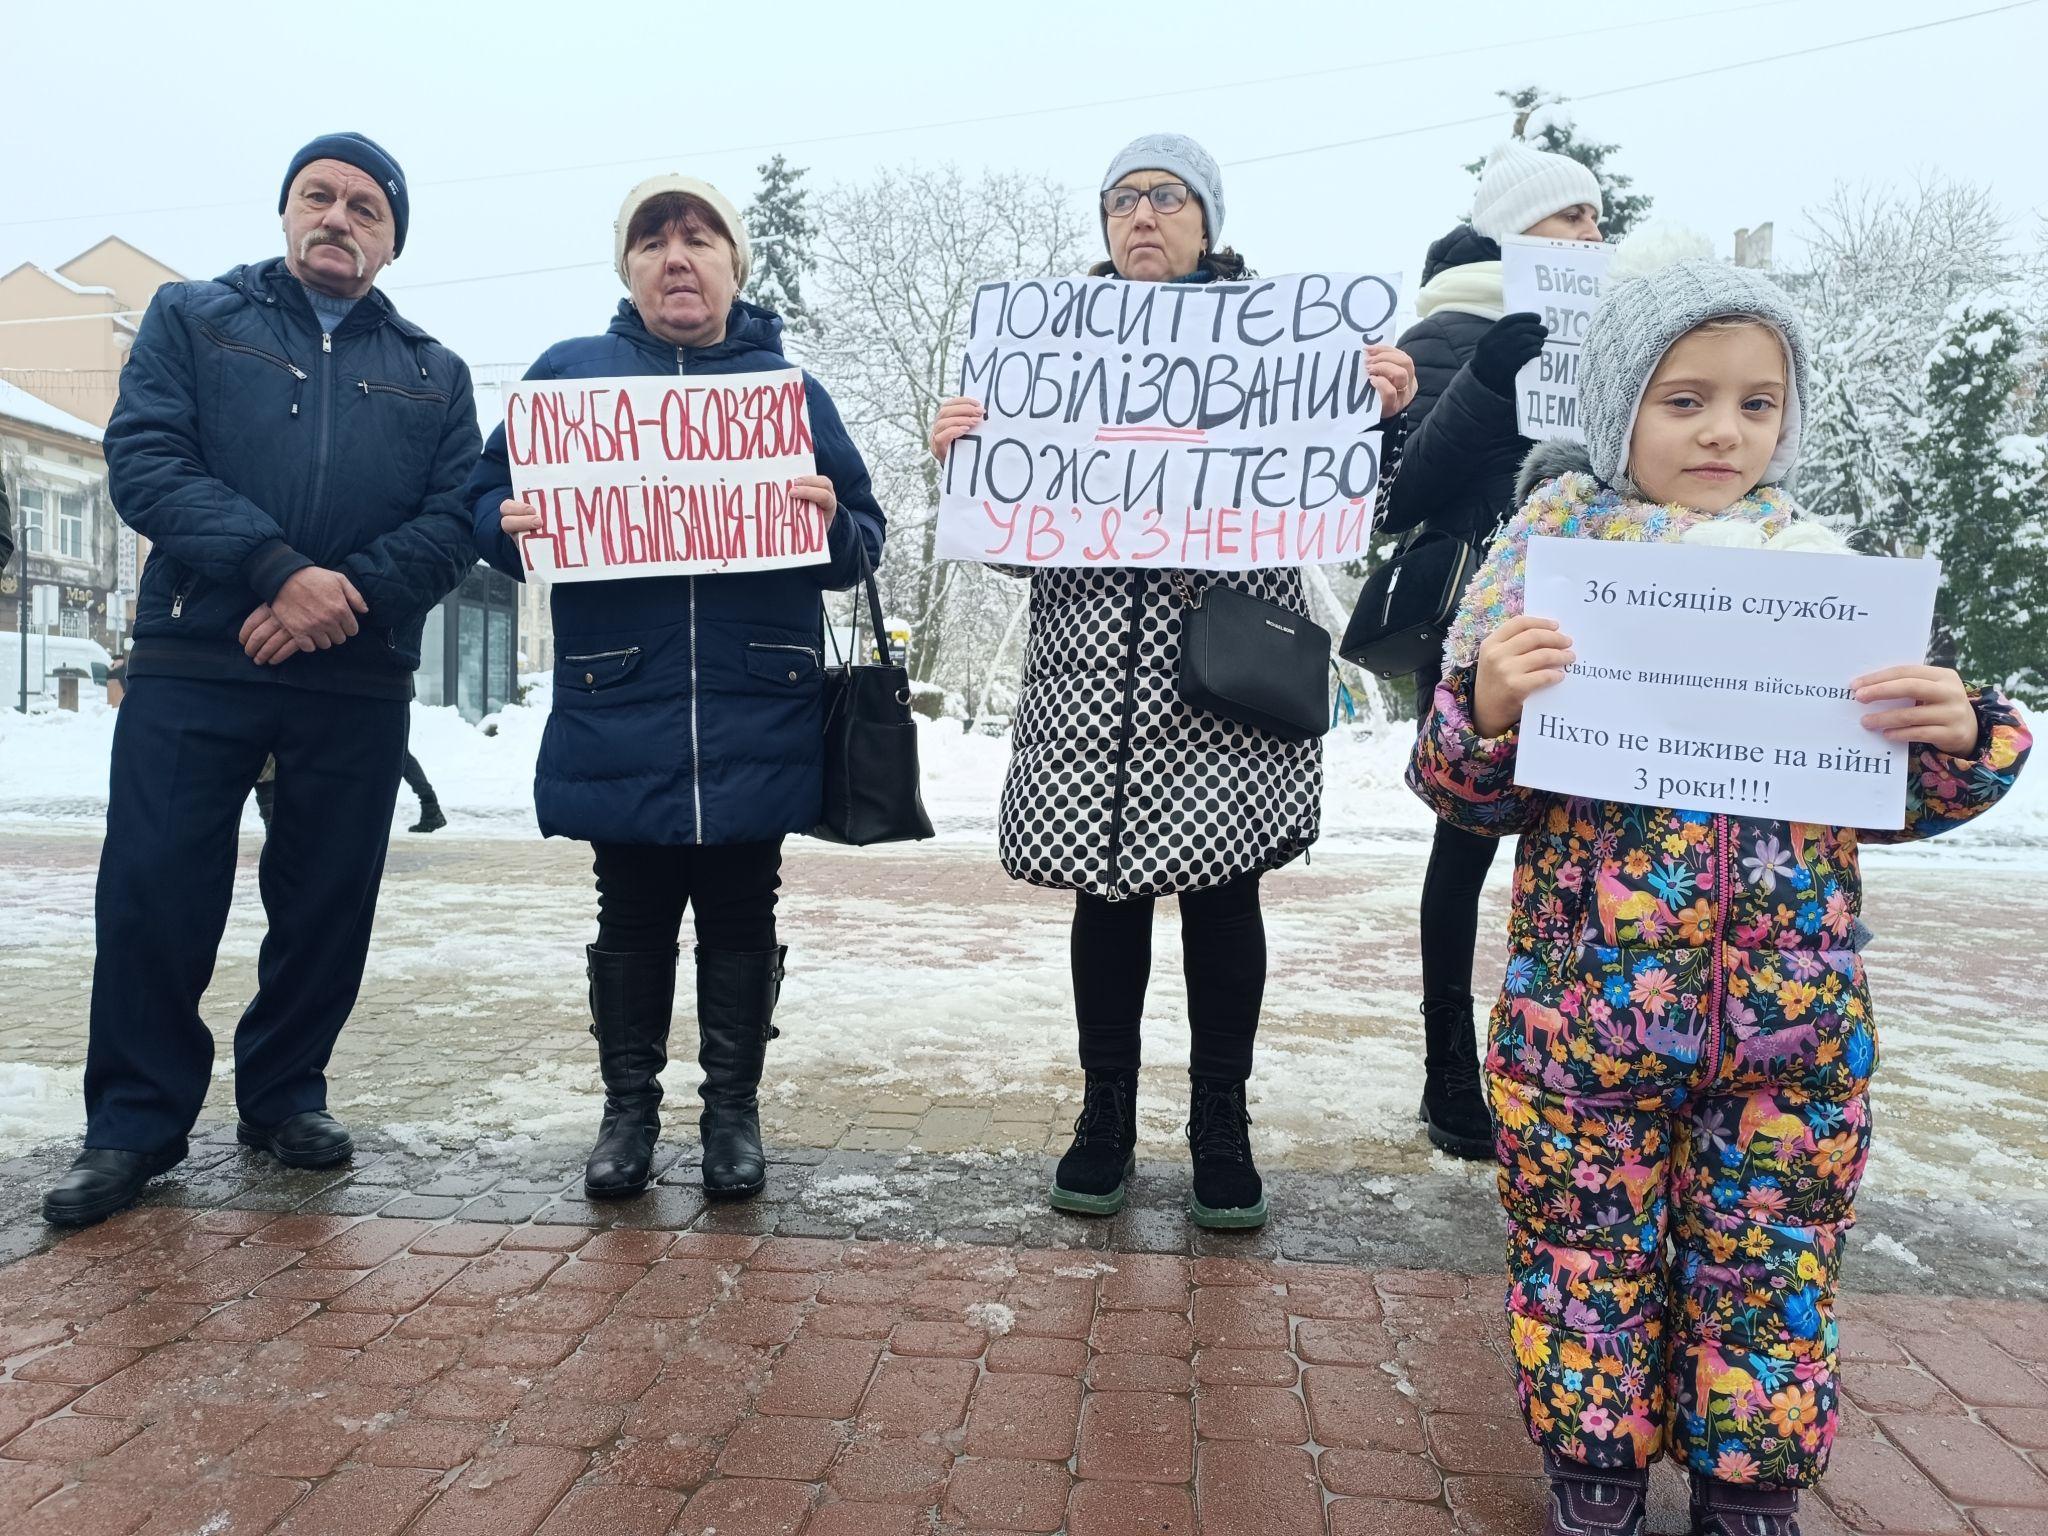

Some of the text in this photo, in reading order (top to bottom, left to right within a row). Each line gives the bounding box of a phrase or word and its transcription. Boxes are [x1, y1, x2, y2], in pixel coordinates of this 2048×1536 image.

[969, 273, 1397, 347] ПОЖИТТЄВО
[1527, 390, 1582, 429] ДЕМ
[1583, 579, 1869, 623] 36 місяців служби-
[1564, 660, 1632, 681] свідоме
[1638, 671, 1748, 692] винищення
[1538, 713, 1892, 775] Ніхто не виживе на війні
[1633, 767, 1771, 804] 3 роки!!!!
